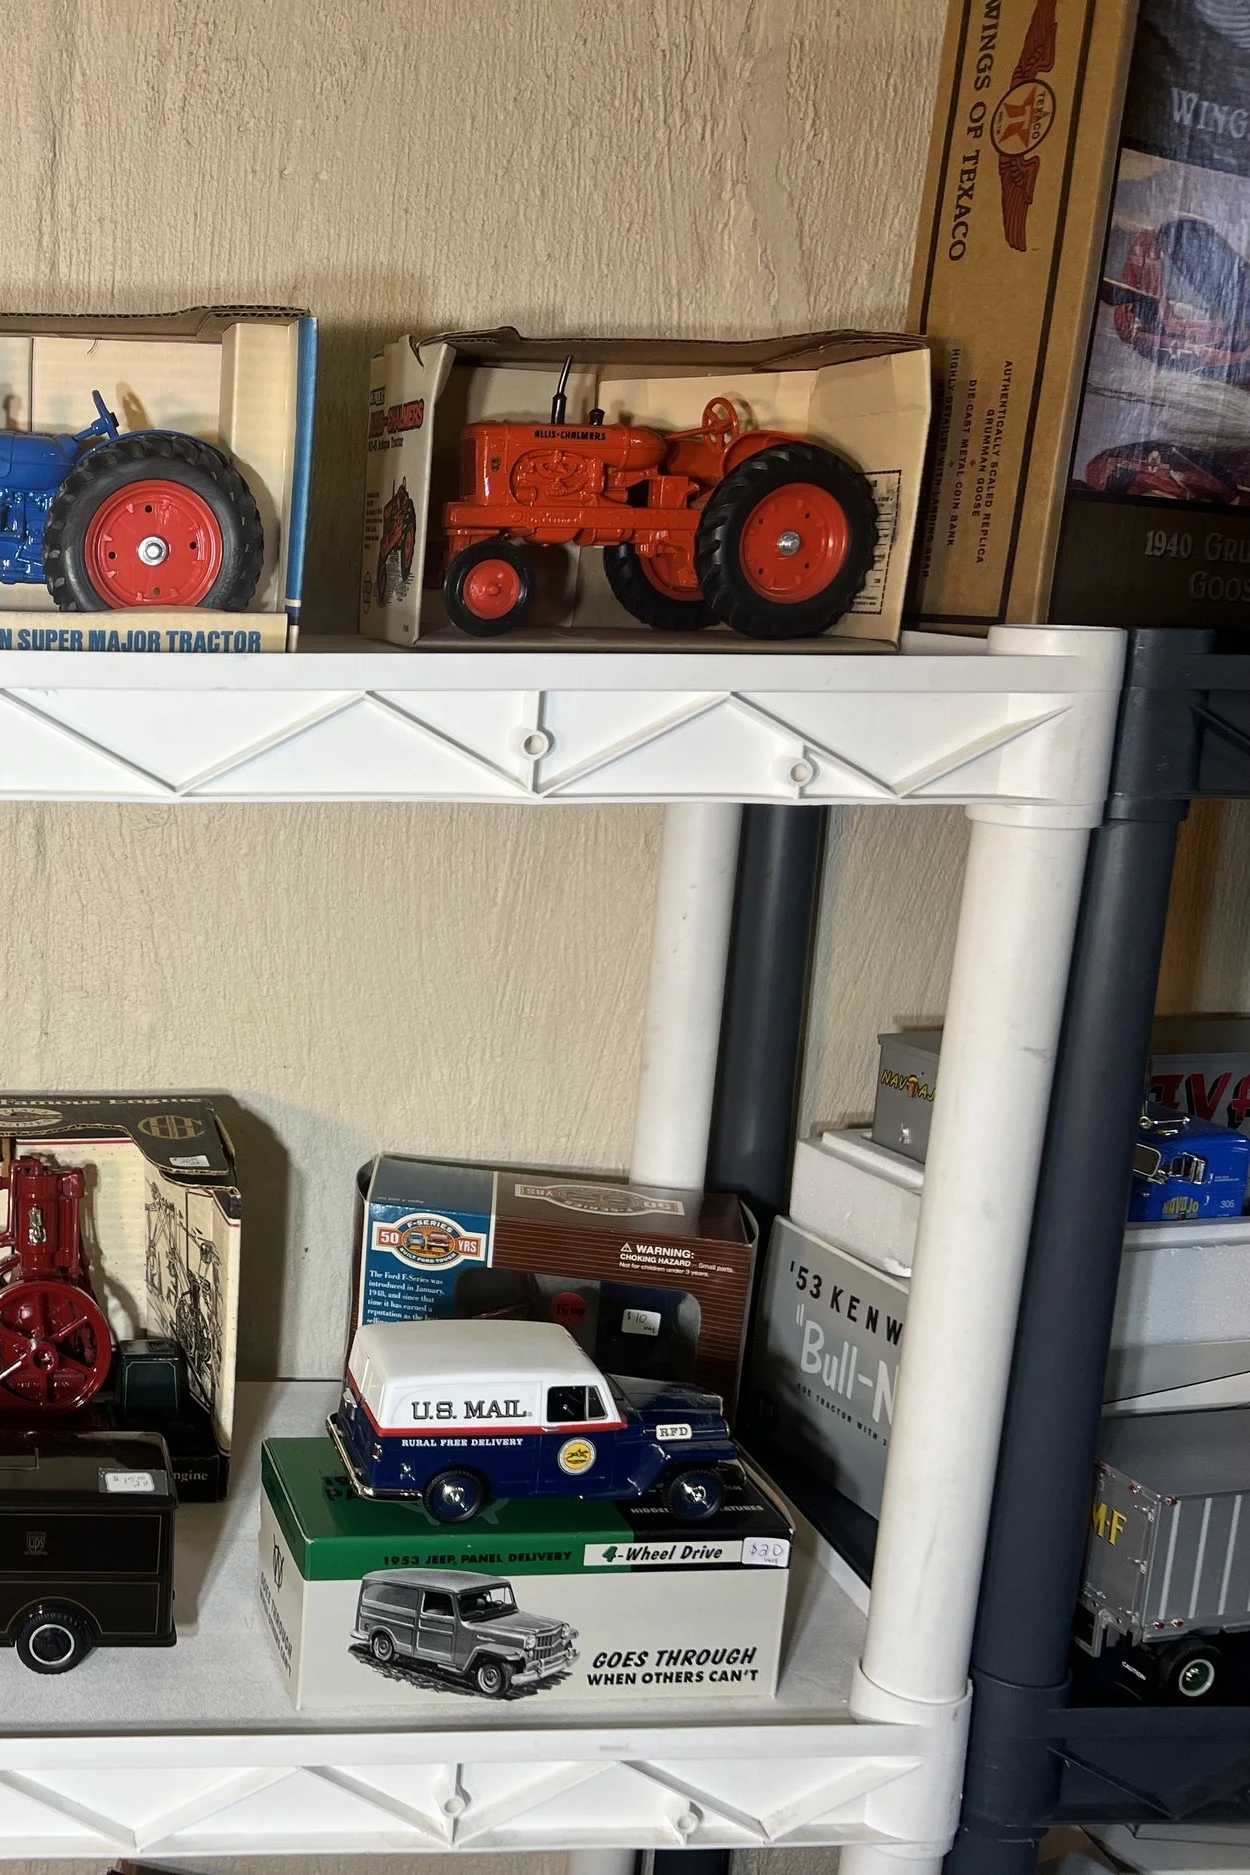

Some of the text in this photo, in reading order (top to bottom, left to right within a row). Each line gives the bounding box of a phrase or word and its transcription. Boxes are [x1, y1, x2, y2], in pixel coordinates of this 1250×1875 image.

[1031, 90, 1050, 140] TEXACO
[1171, 87, 1250, 141] WING
[949, 0, 1001, 262] WINGS OF TEXACO
[947, 348, 961, 393] HIGHLY
[946, 379, 978, 547] DIE-CAST METAL COIN BANK
[972, 408, 995, 517] GRUMMAN GOOSE
[975, 359, 1014, 564] AUTHENTICALLY SCALED REPLICA
[1145, 529, 1250, 565] 1940 GRU
[17, 628, 83, 651] SUPER
[88, 629, 161, 652] MAJOR
[165, 630, 261, 653] TRACTOR
[0, 1098, 102, 1106] Famous
[109, 1096, 203, 1106] Engine
[406, 1218, 454, 1234] F-SERIES
[380, 1231, 400, 1245] 50
[457, 1239, 478, 1254] YRS
[416, 1256, 436, 1264] FORD
[635, 1244, 696, 1260] WARNING:
[619, 1252, 657, 1264] CHOKING
[657, 1256, 692, 1268] HAZARD
[698, 1261, 716, 1272] Small
[619, 1261, 630, 1270] Not
[630, 1262, 640, 1271] for
[640, 1263, 666, 1273] children
[665, 1266, 684, 1275] under
[368, 1269, 444, 1285] The Ford F-Series was
[368, 1279, 406, 1291] introduced
[415, 1284, 446, 1297] January,
[368, 1288, 436, 1304] 1948, and since that
[367, 1298, 383, 1307] time
[390, 1301, 403, 1309] has
[403, 1303, 428, 1313] earned
[789, 1260, 904, 1346] '53 KENW
[366, 1308, 403, 1320] reputation
[412, 1311, 424, 1320] the
[411, 1400, 458, 1421] U.S.
[816, 1394, 853, 1424] TRACTOR
[857, 1421, 878, 1441] WITH
[658, 1426, 690, 1438] RFD
[401, 1437, 524, 1447] RURAL FREE DELIVERY
[173, 1469, 209, 1483] ngine
[720, 1504, 765, 1513] ATURES
[382, 1554, 421, 1566] 1953
[460, 1552, 505, 1565] PANEL
[507, 1551, 572, 1564] DELIVERY
[601, 1544, 724, 1562] 4-Wheel Drive
[749, 1542, 784, 1558] $20
[592, 1645, 758, 1669] GOES THROUGH
[587, 1668, 759, 1686] WHEN OTHERS CAN'T
